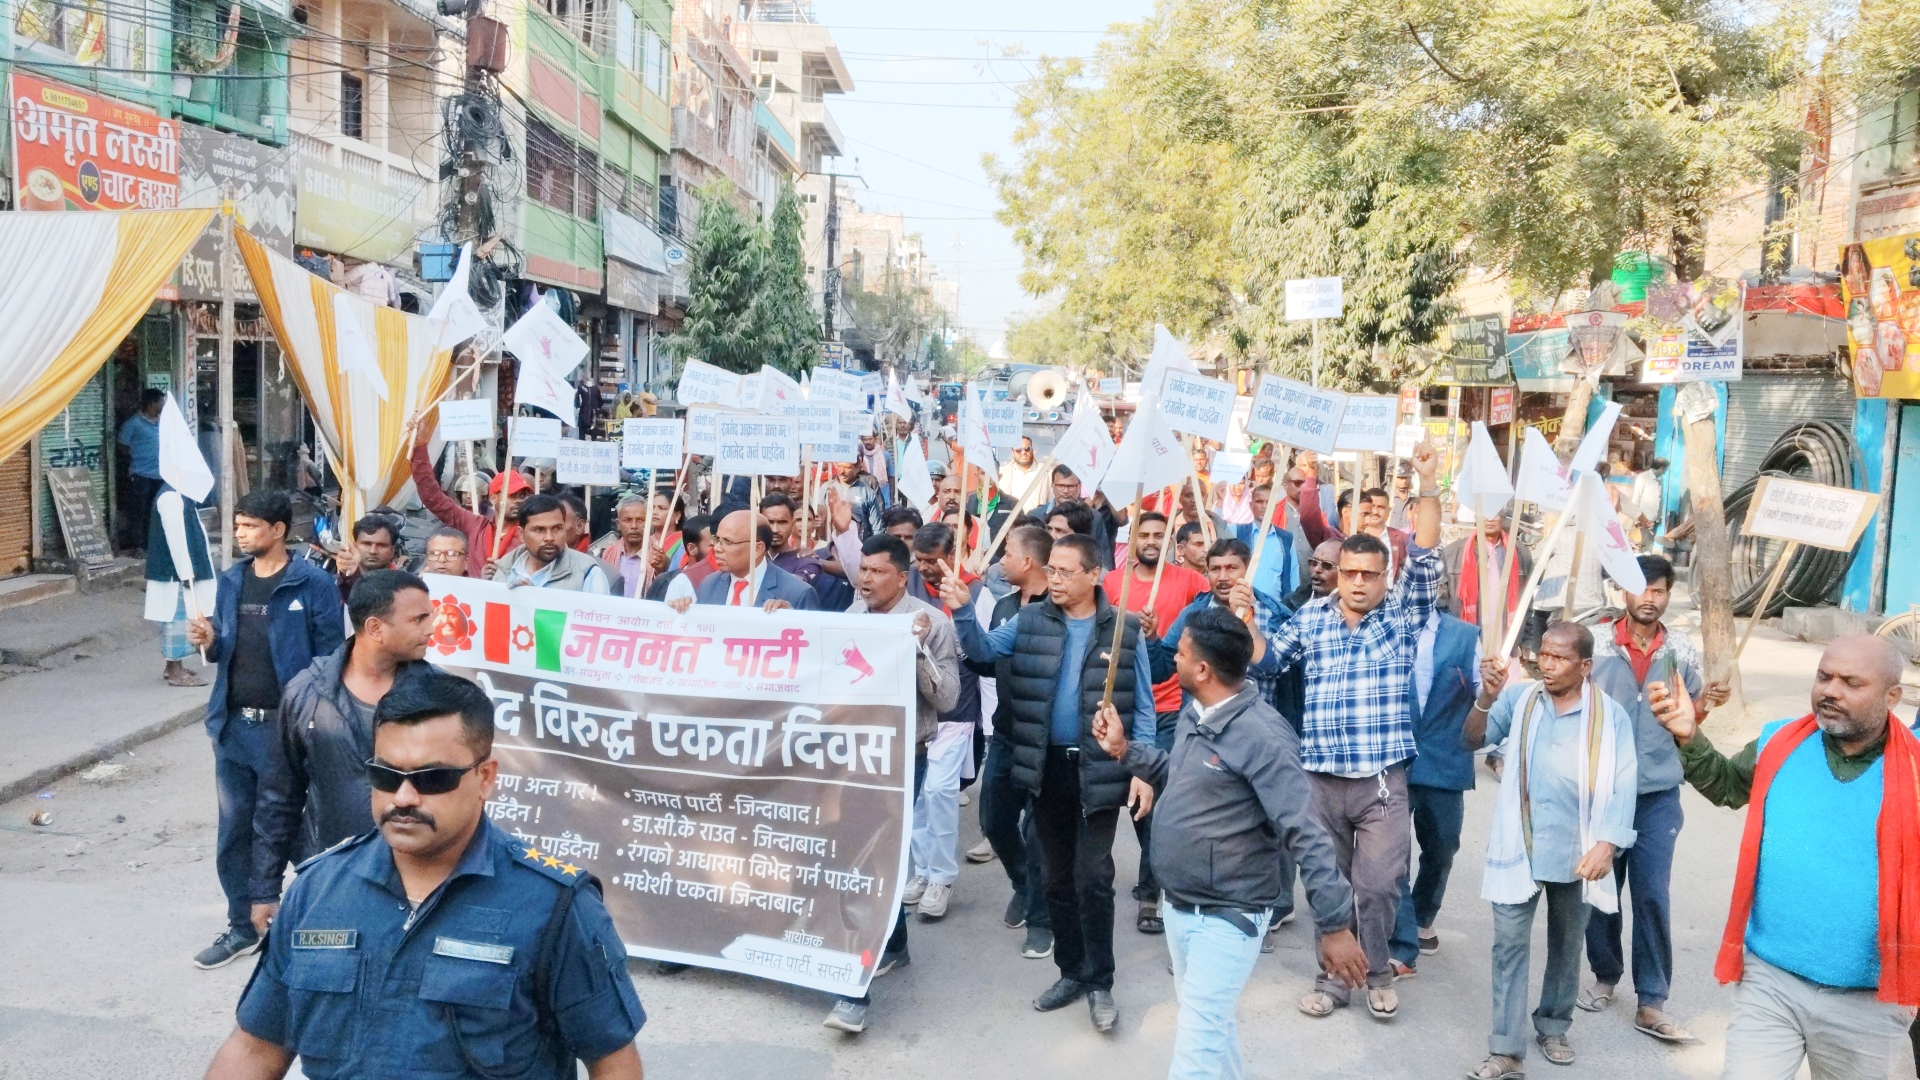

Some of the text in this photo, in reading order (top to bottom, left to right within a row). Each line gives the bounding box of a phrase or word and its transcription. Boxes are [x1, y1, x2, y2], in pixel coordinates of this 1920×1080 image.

[17, 96, 177, 175] अमृत लस्सी
[212, 163, 233, 177] VIDEO
[81, 169, 177, 209] एण्ड चाट हाउस
[305, 167, 412, 224] SNEHA COLLECTION
[1652, 346, 1680, 355] BBA
[1654, 360, 1677, 369] MBA
[1682, 360, 1735, 371] DREAM
[1152, 437, 1169, 456] पार्टी
[573, 608, 610, 623] निर्वाचन
[617, 616, 649, 629] आयोग
[656, 619, 675, 631] दर्ता
[565, 624, 810, 680] जनमत पार्टी
[677, 676, 717, 689] सामाजिक
[722, 679, 742, 690] न्याय
[756, 683, 800, 694] समाजवाद
[530, 680, 638, 760] विरुद्ध
[646, 712, 773, 768] एकता
[782, 705, 896, 776] दिवस
[525, 776, 561, 797] अन्त
[564, 780, 589, 800] गर
[631, 788, 681, 810] जनमत
[684, 793, 722, 813] पार्टी
[699, 822, 737, 844] राउत
[753, 824, 827, 857] जिन्दाबाद
[627, 840, 674, 866] रंगको
[676, 849, 746, 875] आधारमा
[749, 853, 792, 882] विभेद
[796, 863, 821, 886] गर्न
[824, 867, 874, 895] पाउदैन
[623, 869, 673, 896] मधेशी
[676, 879, 726, 903] एकता
[730, 881, 806, 916] जिन्दाबाद
[299, 932, 349, 945] R.K.SINGH
[439, 939, 510, 960] NEPAL POLICE
[782, 929, 824, 948] आयोजक
[745, 948, 783, 968] जनमत
[818, 963, 853, 983] सप्तरी
